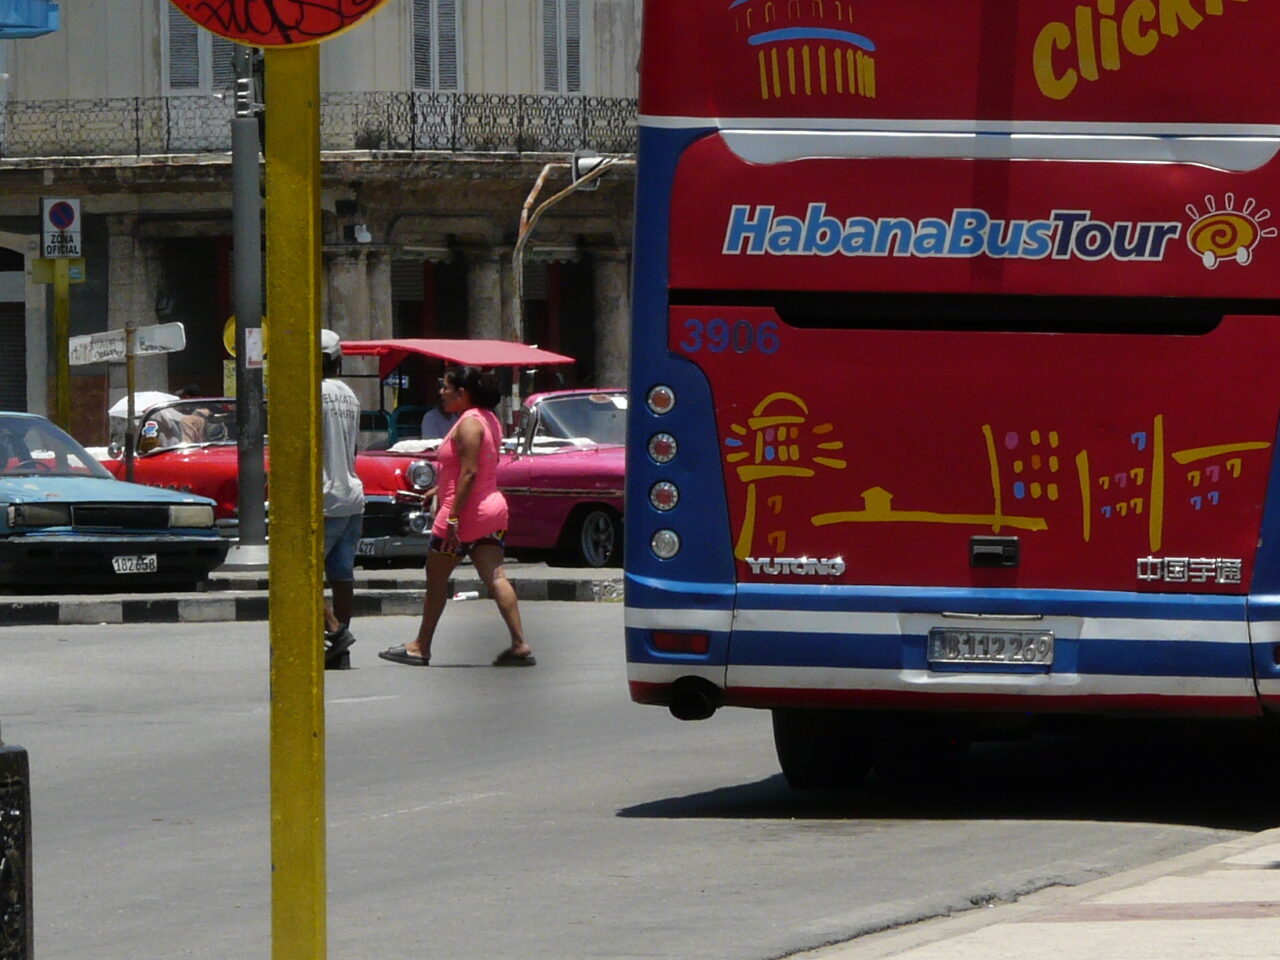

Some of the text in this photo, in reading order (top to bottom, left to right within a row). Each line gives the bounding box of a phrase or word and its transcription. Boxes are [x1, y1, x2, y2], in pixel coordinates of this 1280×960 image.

[50, 233, 74, 245] ZONA
[722, 202, 1181, 262] HabanaBusTour
[46, 244, 79, 255] OFICIAL
[680, 318, 781, 355] 3906
[745, 556, 846, 576] YUTONG
[1136, 555, 1242, 584] 中国宇通
